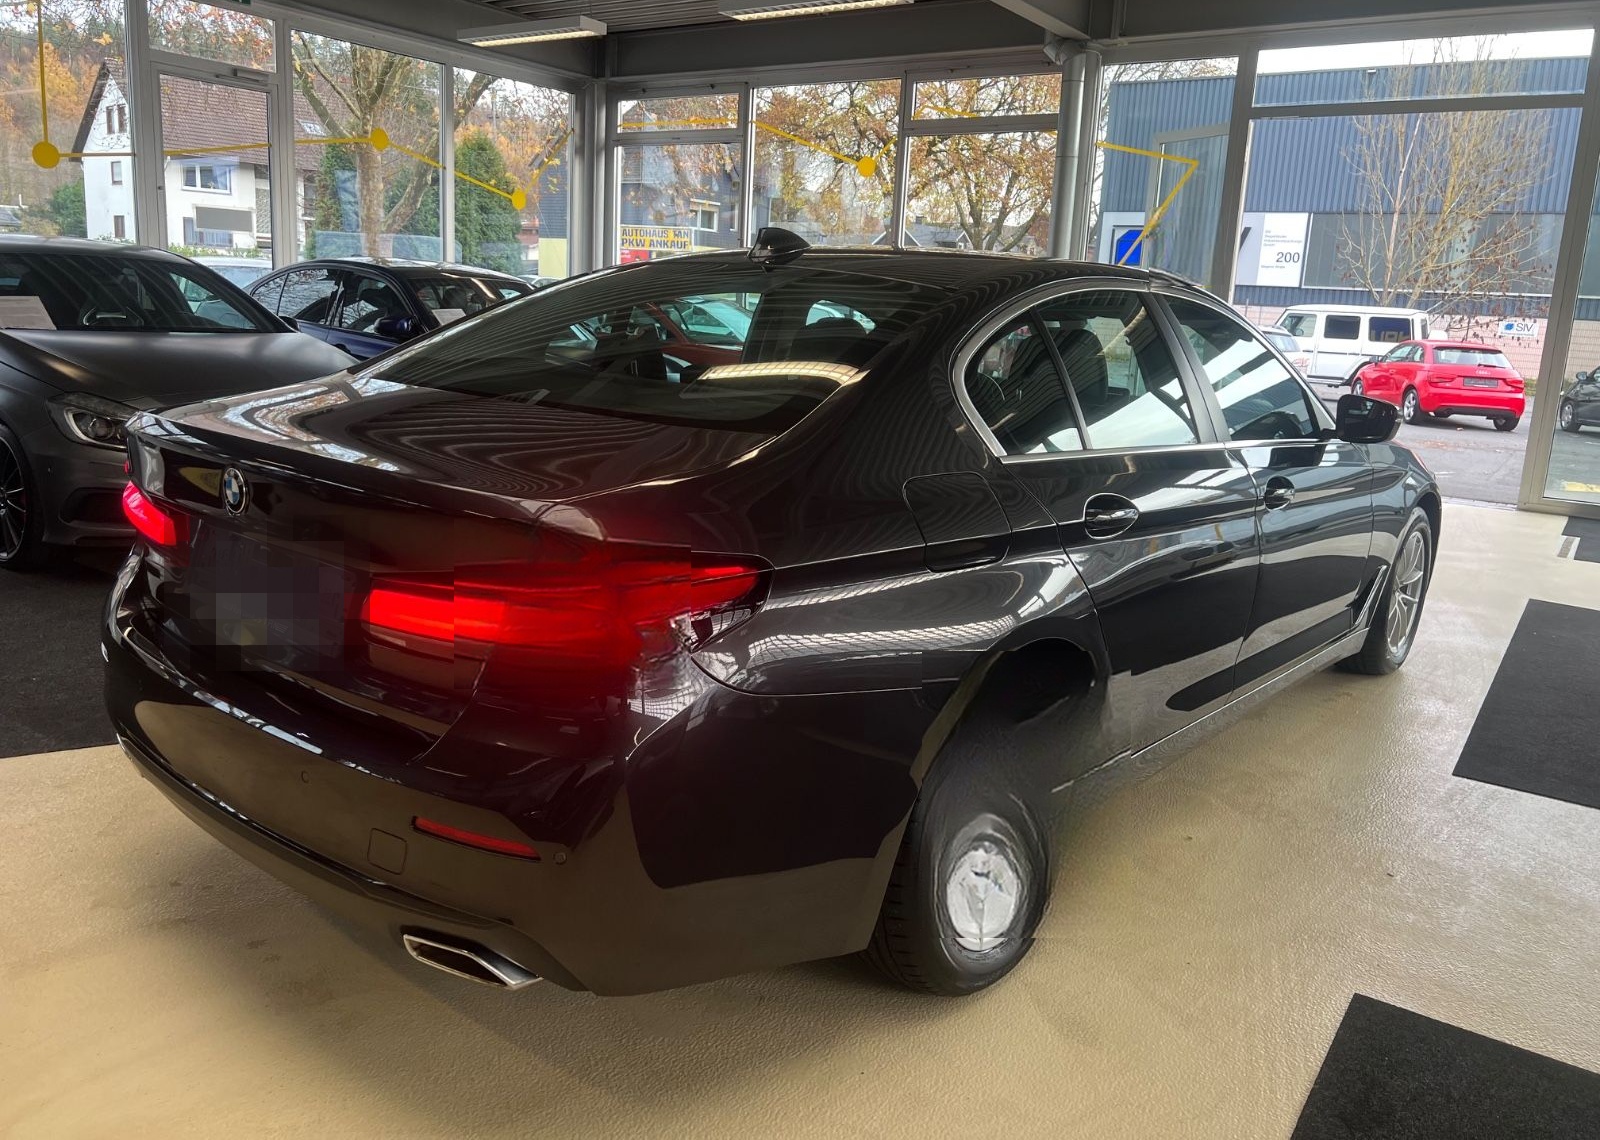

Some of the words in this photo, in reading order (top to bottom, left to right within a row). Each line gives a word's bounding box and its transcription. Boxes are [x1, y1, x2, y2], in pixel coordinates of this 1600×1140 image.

[622, 228, 668, 238] AUTOHAUS
[621, 238, 646, 247] PKW
[649, 240, 688, 249] ANKAUF
[1276, 252, 1300, 263] 200
[1515, 322, 1533, 332] SIV
